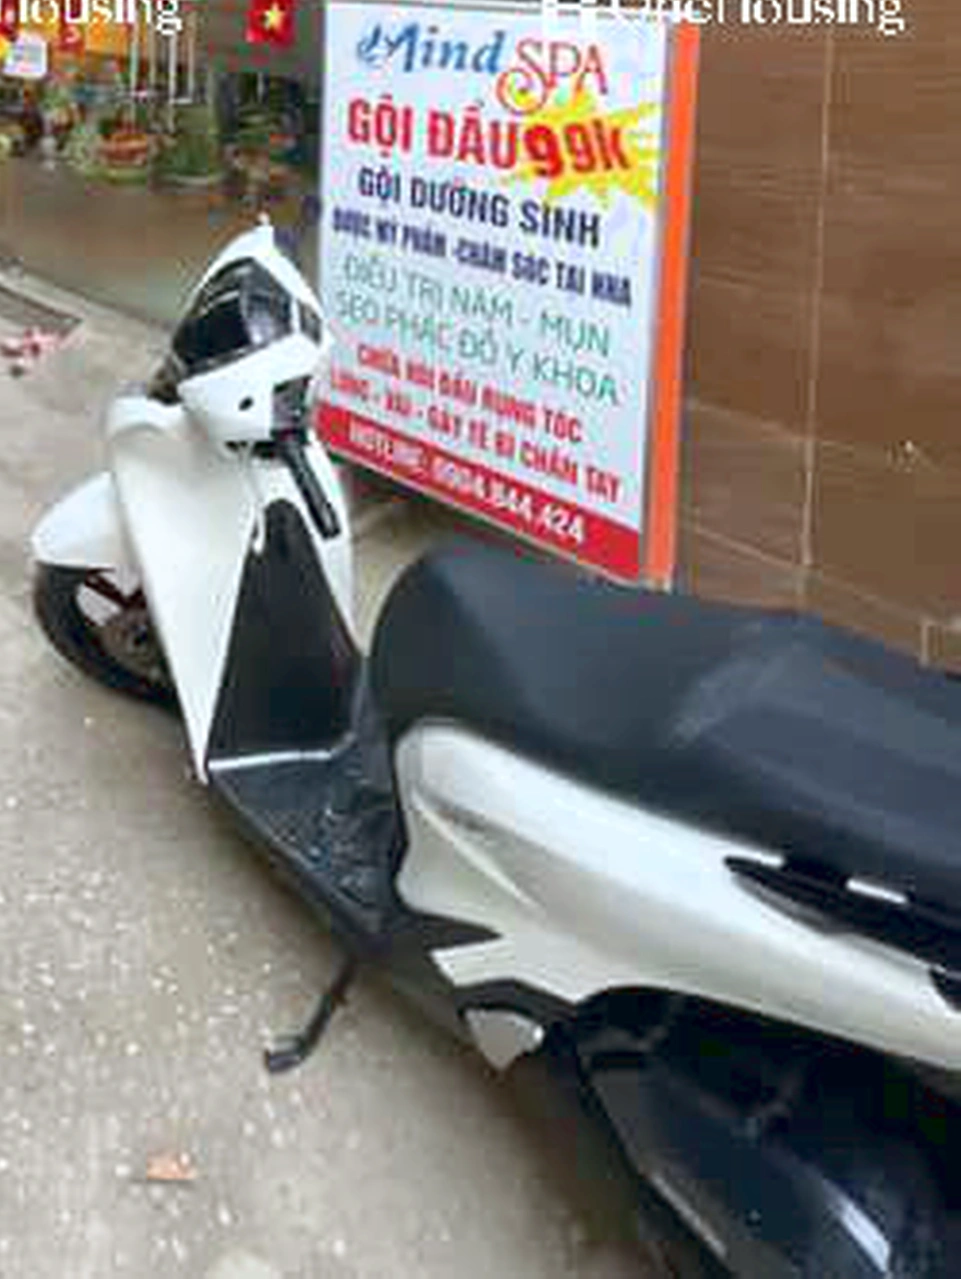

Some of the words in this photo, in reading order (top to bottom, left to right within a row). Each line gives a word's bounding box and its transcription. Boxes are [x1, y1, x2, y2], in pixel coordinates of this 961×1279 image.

[496, 38, 609, 116] SPA
[347, 94, 412, 158] GỘI
[357, 164, 401, 207] GỘI
[519, 199, 601, 249] SINH
[532, 352, 620, 408] KHOA
